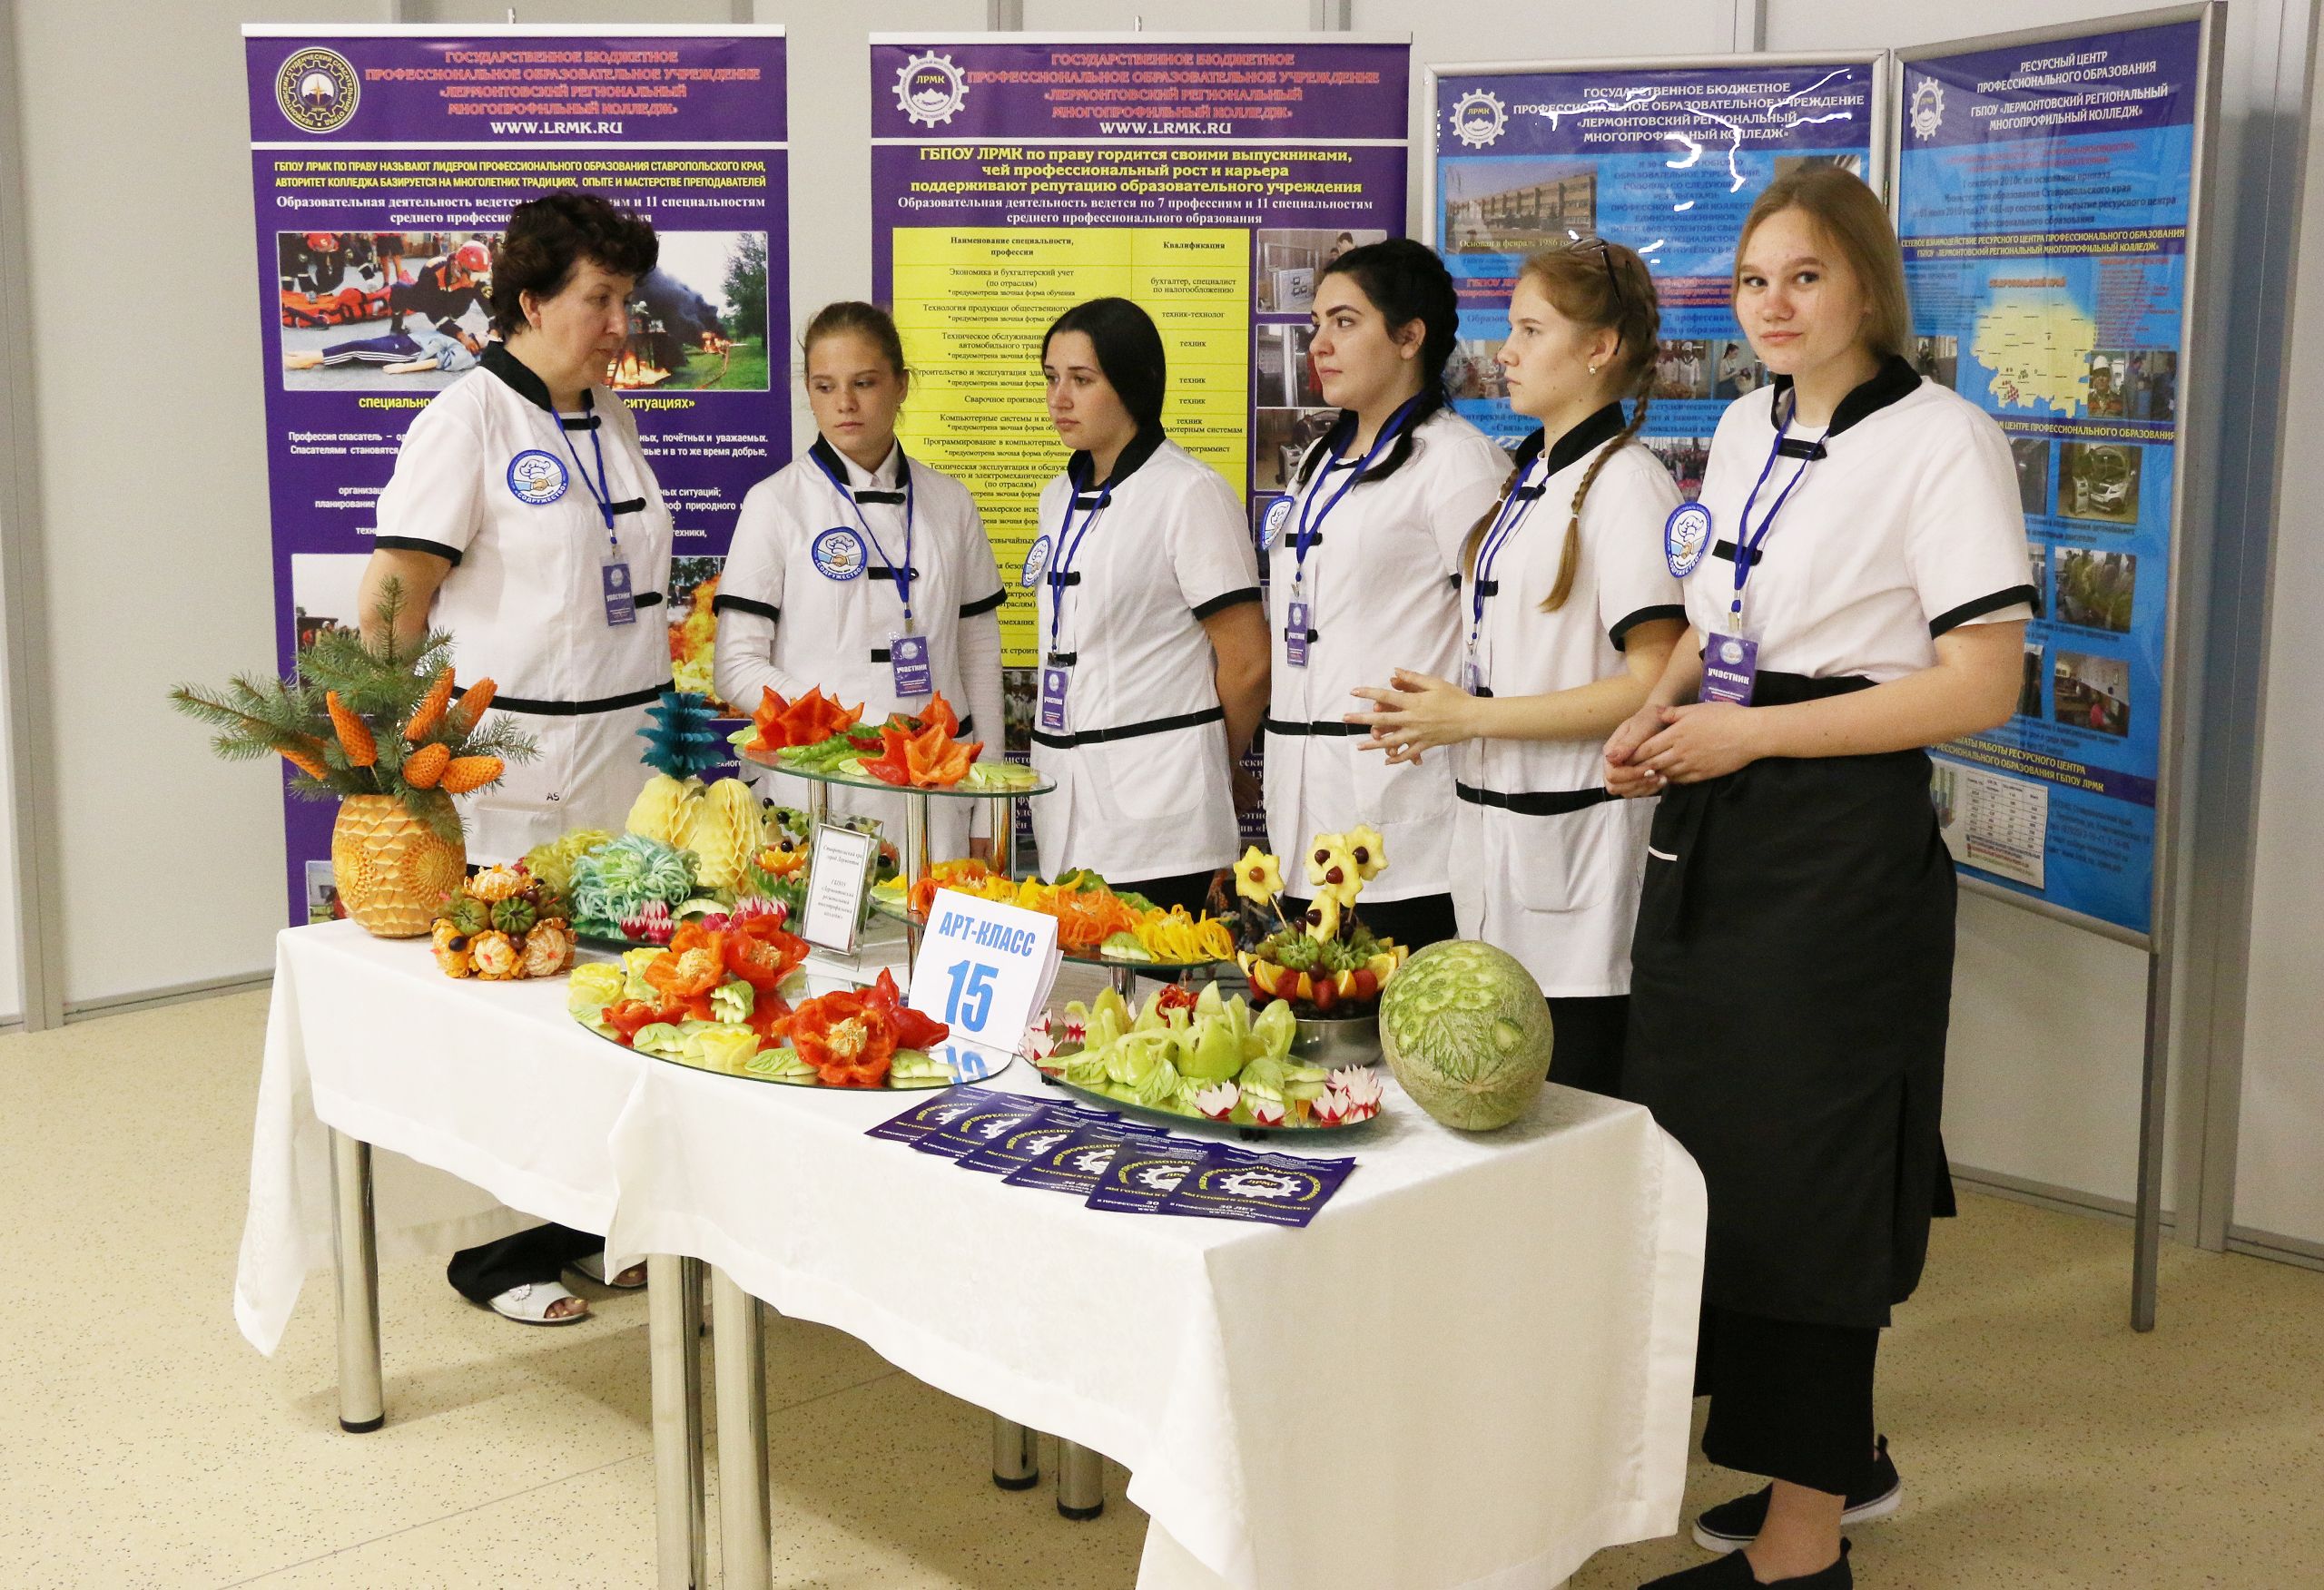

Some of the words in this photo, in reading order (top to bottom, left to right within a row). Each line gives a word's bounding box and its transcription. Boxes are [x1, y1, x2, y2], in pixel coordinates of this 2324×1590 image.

[445, 52, 582, 64] ГОСУДАРСТВЕННОЕ
[585, 51, 678, 64] БЮДЖЕТНОЕ
[1051, 54, 1194, 67] ГОСУДАРСТВЕННОЕ
[1196, 54, 1295, 67] БЮДЖЕТНОЕ
[2020, 54, 2075, 73] РЕСУРСНЫЙ
[2076, 51, 2108, 65] ЦЕНТР
[365, 69, 521, 81] ПРОФЕССИОНАЛЬНОЕ
[523, 69, 661, 80] ОБРАЗОВАТЕЛЬНОЕ
[664, 69, 761, 82] УЧРЕЖДЕНИЕ
[916, 75, 945, 84] ЛРМК
[967, 71, 1130, 83] ПРОФЕССИОНАЛЬНОЕ
[1132, 72, 1276, 83] ОБРАЗОВАТЕЛЬНОЕ
[1279, 72, 1380, 85] УЧРЕЖДЕНИЕ
[1976, 71, 2081, 93] ПРОФЕССИОНАЛЬНОГО
[2083, 61, 2157, 80] ОБРАЗОВАНИЯ
[571, 83, 687, 97] РЕГИОНАЛЬНЫЙ
[1181, 87, 1303, 101] РЕГИОНАЛЬНЫЙ
[1707, 83, 1790, 95] БЮДЖЕТНОЕ
[1651, 99, 1775, 111] ОБРАЗОВАТЕЛЬНОЕ
[1971, 104, 1998, 117] ГБПОУ
[2000, 93, 2083, 114] «ЛЕРМОНТОВСКИЙ
[2085, 83, 2168, 105] РЕГИОНАЛЬНЫЙ
[448, 101, 599, 114] МНОГОПРОФИЛЬНЫЙ
[1052, 104, 1211, 118] МНОГОПРОФИЛЬНЫЙ
[1467, 107, 1490, 115] ЛРМК
[1577, 114, 1690, 127] «ЛЕРМОНТОВСКИЙ
[1693, 111, 1797, 125] РЕГОНАЛЬНЫЙ
[1989, 108, 2087, 131] МНОГОПРОФИЛЬНЫЙ
[2089, 105, 2142, 122] КОЛЛЕДЖ»
[490, 122, 623, 134] WWW.LRMK.RU
[1099, 122, 1232, 134] WWW.LRMK.RU
[1583, 129, 1718, 142] МНОГОПРОФЬНЫЙ
[920, 147, 975, 161] ГБПОУ
[977, 147, 1023, 161] ЛРМК
[1027, 151, 1045, 161] по
[1049, 151, 1094, 163] праву
[1098, 151, 1167, 162] гордится
[1171, 151, 1228, 161] своими
[1232, 151, 1353, 163] выпускниками,
[275, 162, 304, 172] ГБПОУ
[306, 162, 331, 172] ЛРМК
[334, 162, 347, 172] ПО
[350, 162, 377, 172] ПРАВУ
[380, 162, 430, 172] НАЗЫВАЮТ
[433, 162, 478, 172] ЛИДЕРОМ
[479, 162, 582, 172] ПРОФЕССИОНАЛЬНОГО
[584, 162, 649, 172] ОБРАЗОВАНИЯ
[651, 162, 739, 172] СТАВРОПОЛЬСКОГО
[741, 162, 766, 172] КРАЯ,
[982, 163, 1010, 176] чей
[1014, 163, 1168, 178] профессиональный
[1173, 166, 1207, 179] рост
[1211, 166, 1221, 176] и
[1225, 166, 1289, 179] карьера
[275, 178, 327, 187] АВТОРИТЕТ
[328, 177, 379, 188] КОЛЛЕДЖА
[380, 178, 438, 187] БАЗИРУЕТСЯ
[438, 178, 452, 187] НА
[454, 178, 519, 187] МНОГОЛЕТНИХ
[522, 178, 578, 188] ТРАДИЦИЯХ,
[582, 178, 614, 187] ОПЫТЕ
[625, 178, 682, 187] МАСТЕРСТВЕ
[684, 175, 766, 188] ПРЕПОДАВАТЕЛЕЙ
[911, 182, 1027, 194] поддерживают
[1030, 182, 1117, 194] репутацию
[1120, 180, 1264, 194] образовательного
[1266, 182, 1363, 194] учреждения
[276, 196, 385, 211] Образовательная
[389, 198, 472, 209] деятельность
[475, 198, 523, 209] ведется
[661, 198, 765, 209] специальностям
[898, 197, 1003, 210] Образовательная
[1006, 199, 1088, 209] деятельность
[1090, 199, 1137, 209] ведется
[1140, 199, 1155, 208] по
[1157, 197, 1165, 208] 7
[1168, 198, 1242, 211] профессиям
[1246, 200, 1253, 209] и
[1257, 198, 1268, 209] 11
[1273, 200, 1374, 211] специальностям
[390, 213, 443, 225] среднего
[1007, 213, 1059, 224] среднего
[1062, 212, 1183, 225] профессионального
[1186, 213, 1263, 226] образования
[950, 237, 1009, 245] Наименование
[1011, 237, 1074, 246] специальности,
[1978, 235, 2019, 245] РЕСУРСНОГО
[2020, 234, 2044, 244] ЦЕНТРА
[2045, 231, 2128, 242] ПРОФЕССИОНАЛЬНОГО
[2129, 229, 2185, 240] ОБРАЗОВАНИЯ
[1163, 241, 1226, 250] Квалификация
[2043, 242, 2119, 254] МНОГОПРОФИЛЬНЫЙ
[990, 249, 1034, 257] профессии
[1000, 268, 1056, 277] бухгалтерский
[1150, 277, 1191, 287] бухгалтер,
[1164, 286, 1235, 294] налогообложению
[923, 304, 966, 312] Технология
[968, 305, 1009, 313] продукции
[1010, 305, 1068, 313] общественного
[942, 332, 990, 340] Техническое
[623, 398, 695, 411] ситуациях»
[940, 414, 999, 423] Компьютерные
[289, 431, 337, 443] Профессия
[339, 433, 382, 442] спасатель
[2004, 421, 2030, 431] ЦЕНТРЕ
[2031, 423, 2118, 437] ПРОФЕССИОНАЛЬНОГО
[2120, 428, 2175, 440] ОБРАЗОВАНИЯ
[663, 433, 704, 443] почётных
[715, 435, 768, 447] уважаемых.
[923, 437, 997, 446] Программирование
[290, 445, 347, 455] Спасателями
[350, 447, 399, 456] становятся
[703, 448, 730, 457] время
[732, 448, 767, 457] добрые,
[930, 463, 977, 471] Техническая
[679, 487, 722, 498] ситуаций;
[315, 499, 376, 509] планирование
[685, 503, 736, 511] природного
[1978, 741, 2008, 755] РАБОТЫ
[2009, 748, 2056, 767] РЕСУРСНОГО
[2057, 760, 2085, 775] ЦЕНТРА
[2001, 758, 2055, 780] ОБРАЗОВАНИЯ
[939, 911, 1036, 957] АРТ-КЛАСС
[944, 959, 1000, 1033] 15
